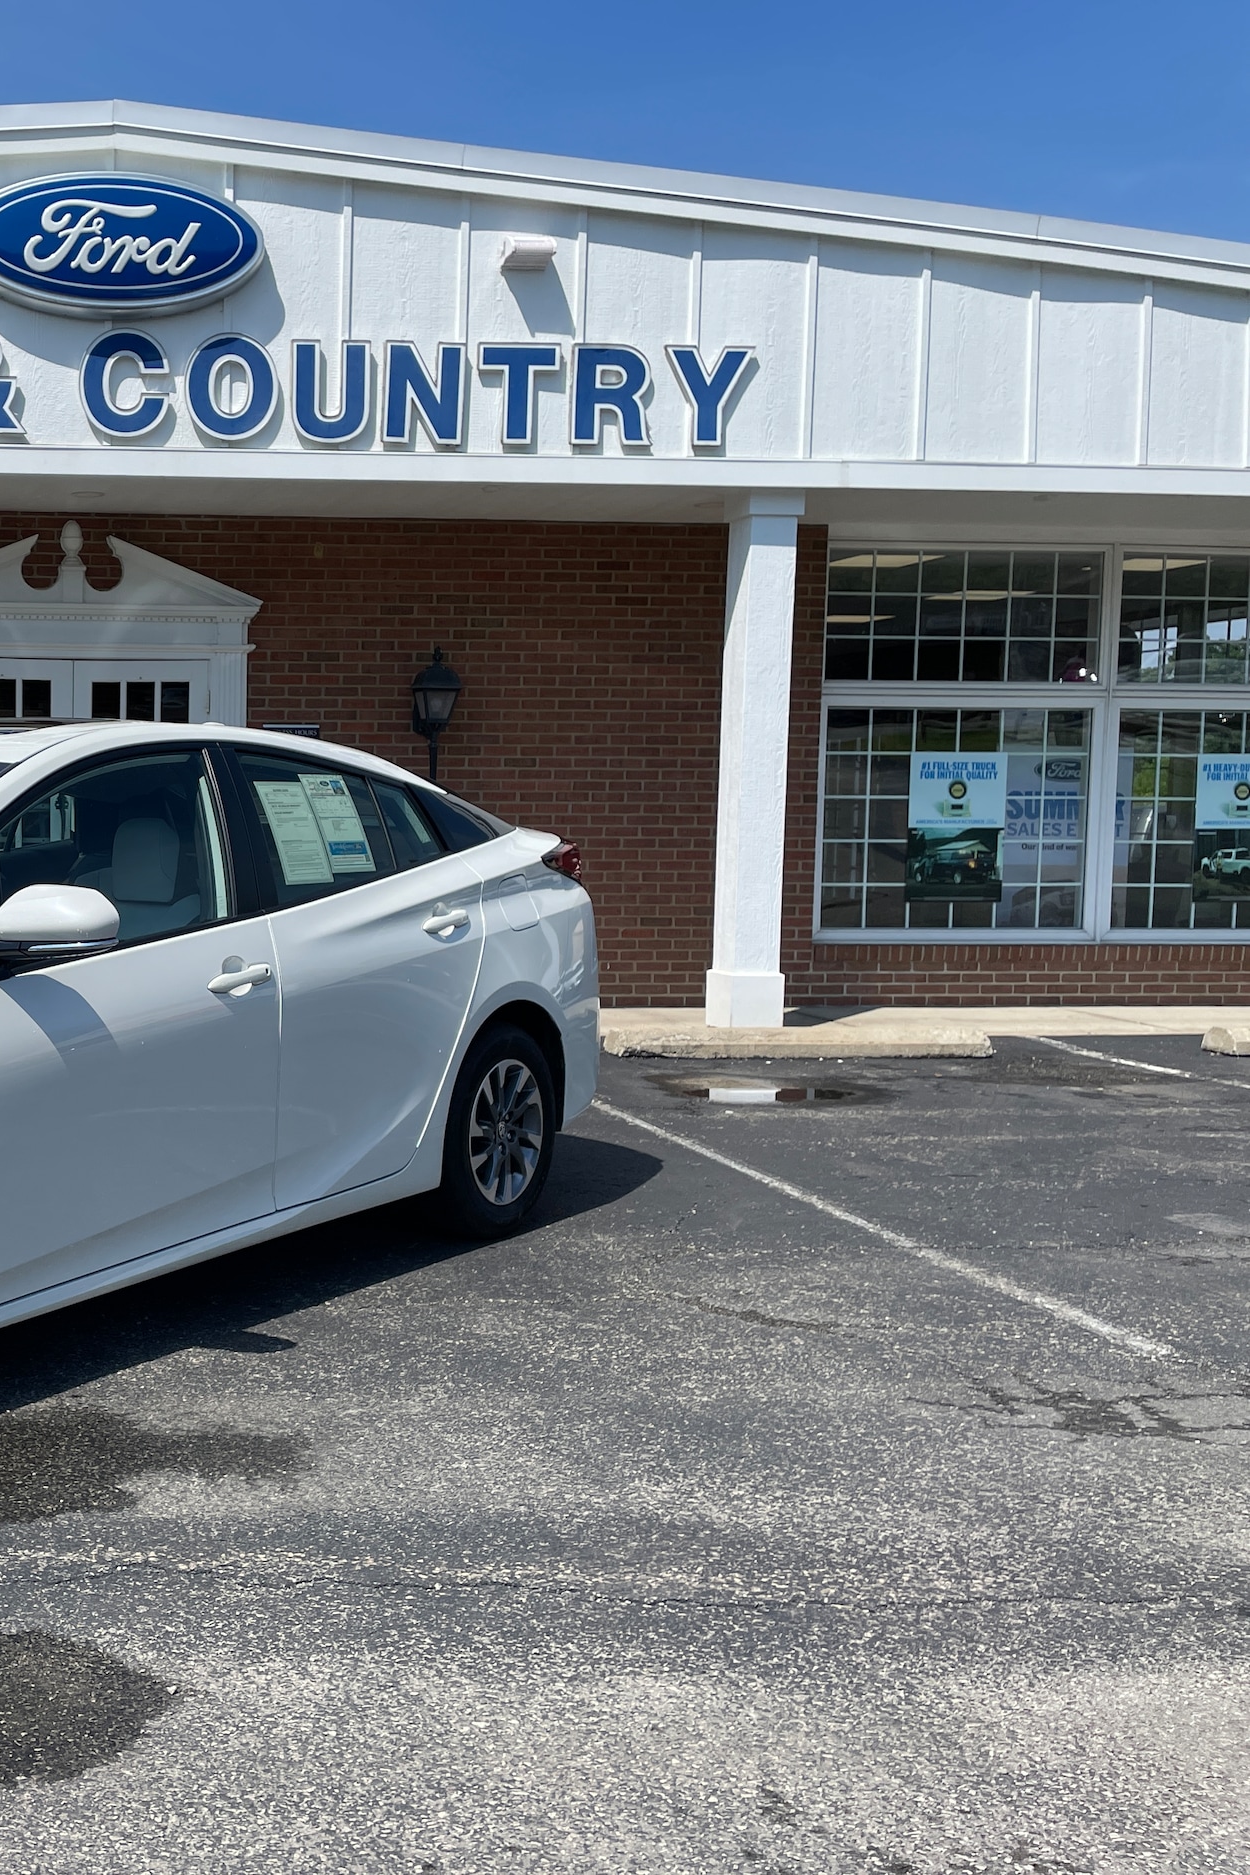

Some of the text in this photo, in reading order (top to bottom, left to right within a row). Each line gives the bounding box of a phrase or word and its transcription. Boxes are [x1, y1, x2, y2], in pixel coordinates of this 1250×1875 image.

[24, 199, 201, 276] Ford
[80, 328, 754, 447] COUNTRY
[933, 761, 969, 771] FULL-SIZE
[971, 761, 996, 771] TRUCK
[920, 770, 998, 781] FOR INITIAL QUALITY
[1207, 772, 1221, 781] FOR
[1006, 822, 1062, 837] SALES
